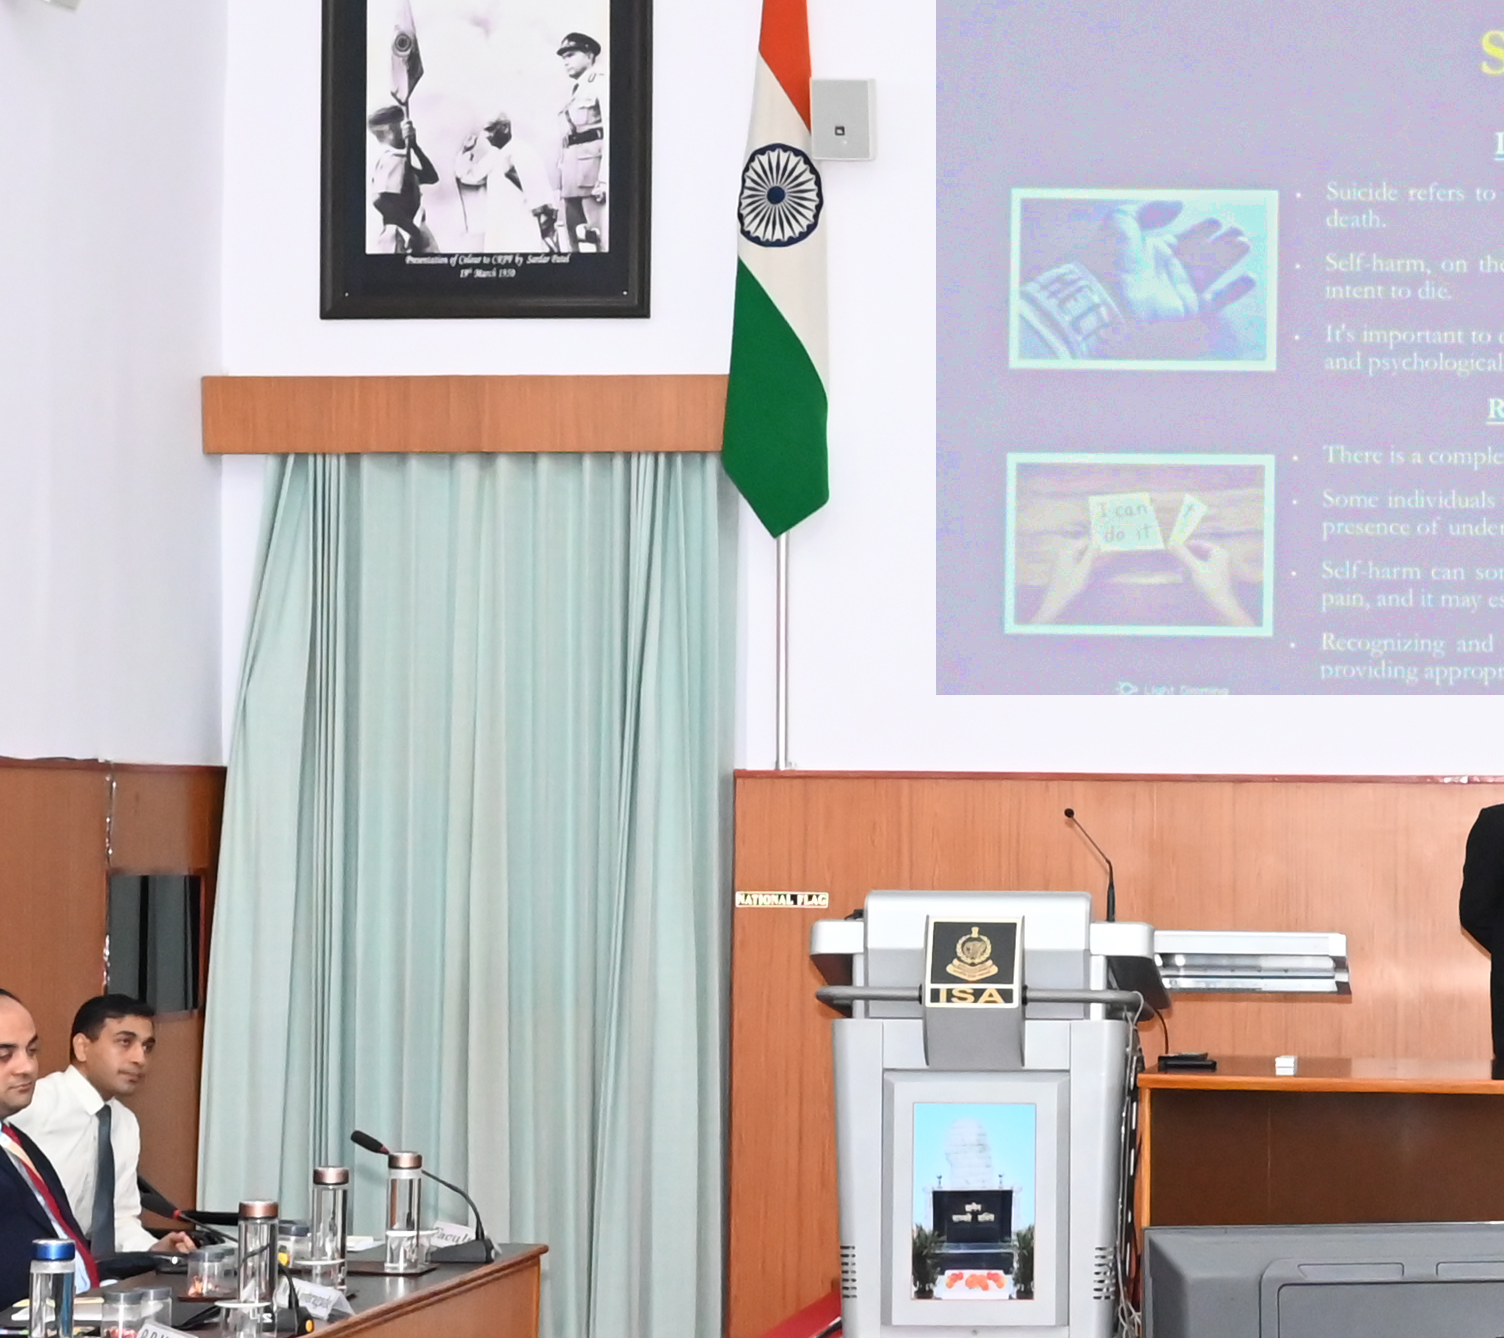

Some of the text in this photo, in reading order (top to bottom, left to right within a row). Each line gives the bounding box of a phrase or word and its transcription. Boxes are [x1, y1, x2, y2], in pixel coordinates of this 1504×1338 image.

[1325, 182, 1399, 201] Suicide
[1407, 183, 1467, 202] refers
[1474, 183, 1497, 202] to
[474, 268, 496, 278] March
[498, 268, 516, 277] 1950
[1438, 260, 1469, 273] on
[1324, 280, 1385, 299] intent
[1389, 281, 1413, 300] to
[737, 893, 827, 906] NATIONAL FLAG
[940, 987, 1005, 1004] ISA
